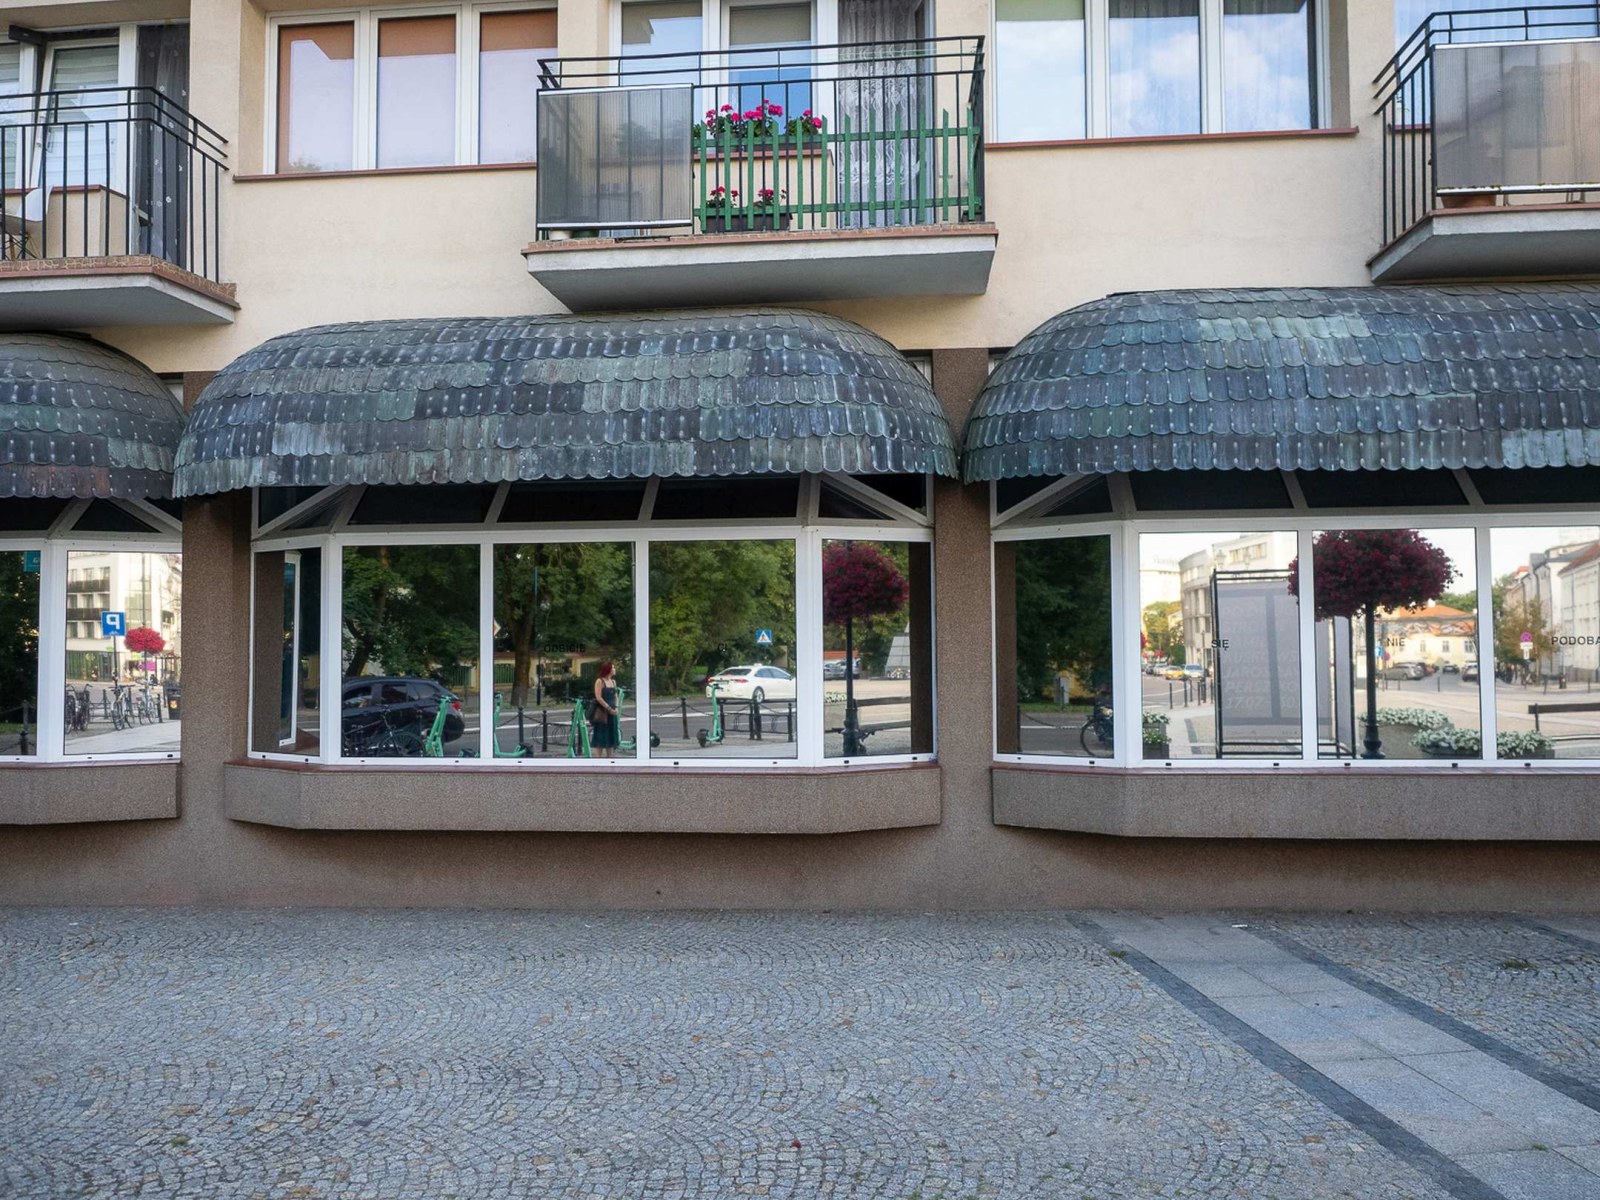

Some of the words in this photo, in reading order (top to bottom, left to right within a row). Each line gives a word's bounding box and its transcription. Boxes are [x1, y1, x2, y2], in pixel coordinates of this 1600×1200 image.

[544, 643, 586, 653] ODBICIE
[1211, 639, 1230, 651] SIĘ
[1387, 636, 1407, 647] NIE
